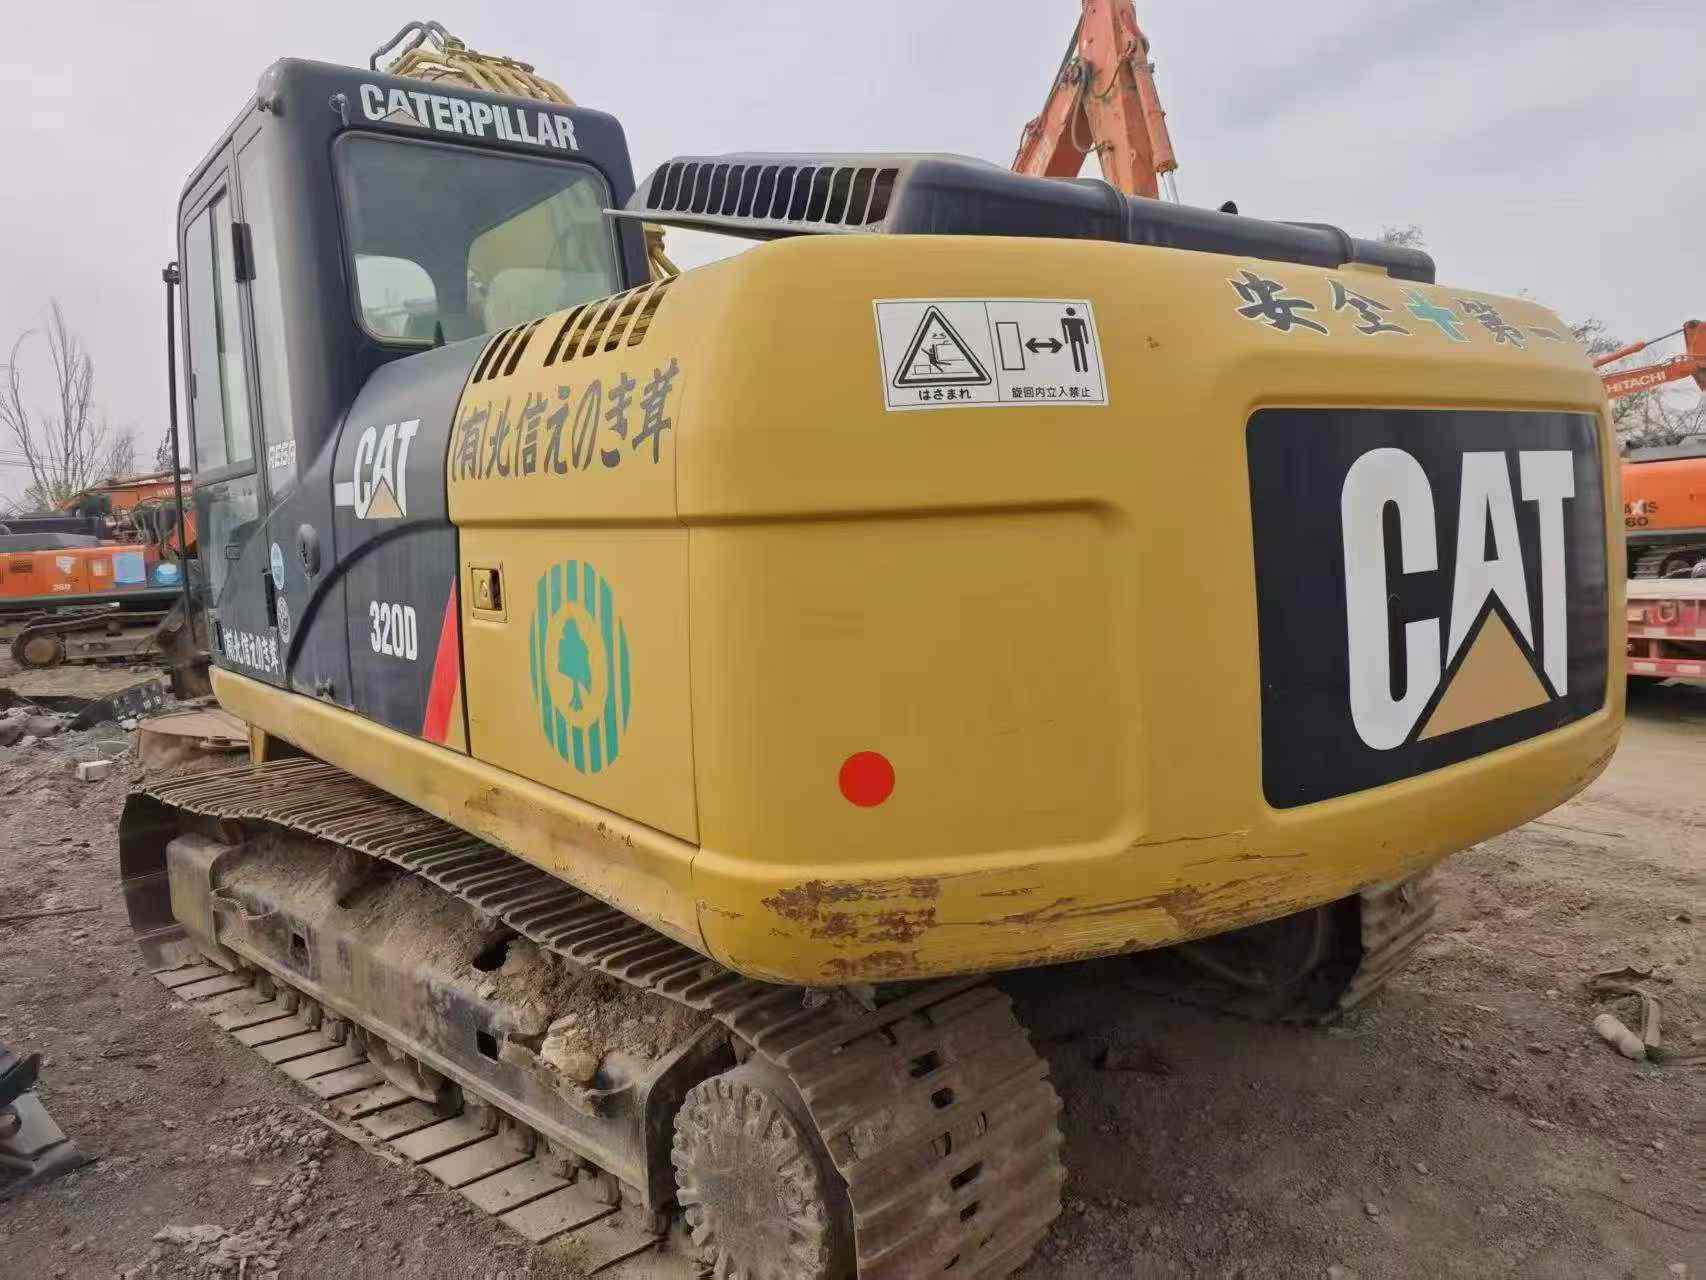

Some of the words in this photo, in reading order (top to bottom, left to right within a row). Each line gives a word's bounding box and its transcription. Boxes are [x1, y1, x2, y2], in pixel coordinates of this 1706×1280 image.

[360, 84, 579, 150] CATERPILLAR
[919, 388, 972, 401] はさまれ
[1011, 386, 1092, 399] 旋回内立入禁止
[1607, 371, 1666, 393] HITACHI
[354, 419, 421, 519] CAT
[1341, 447, 1575, 750] CAT
[369, 601, 417, 661] 320D
